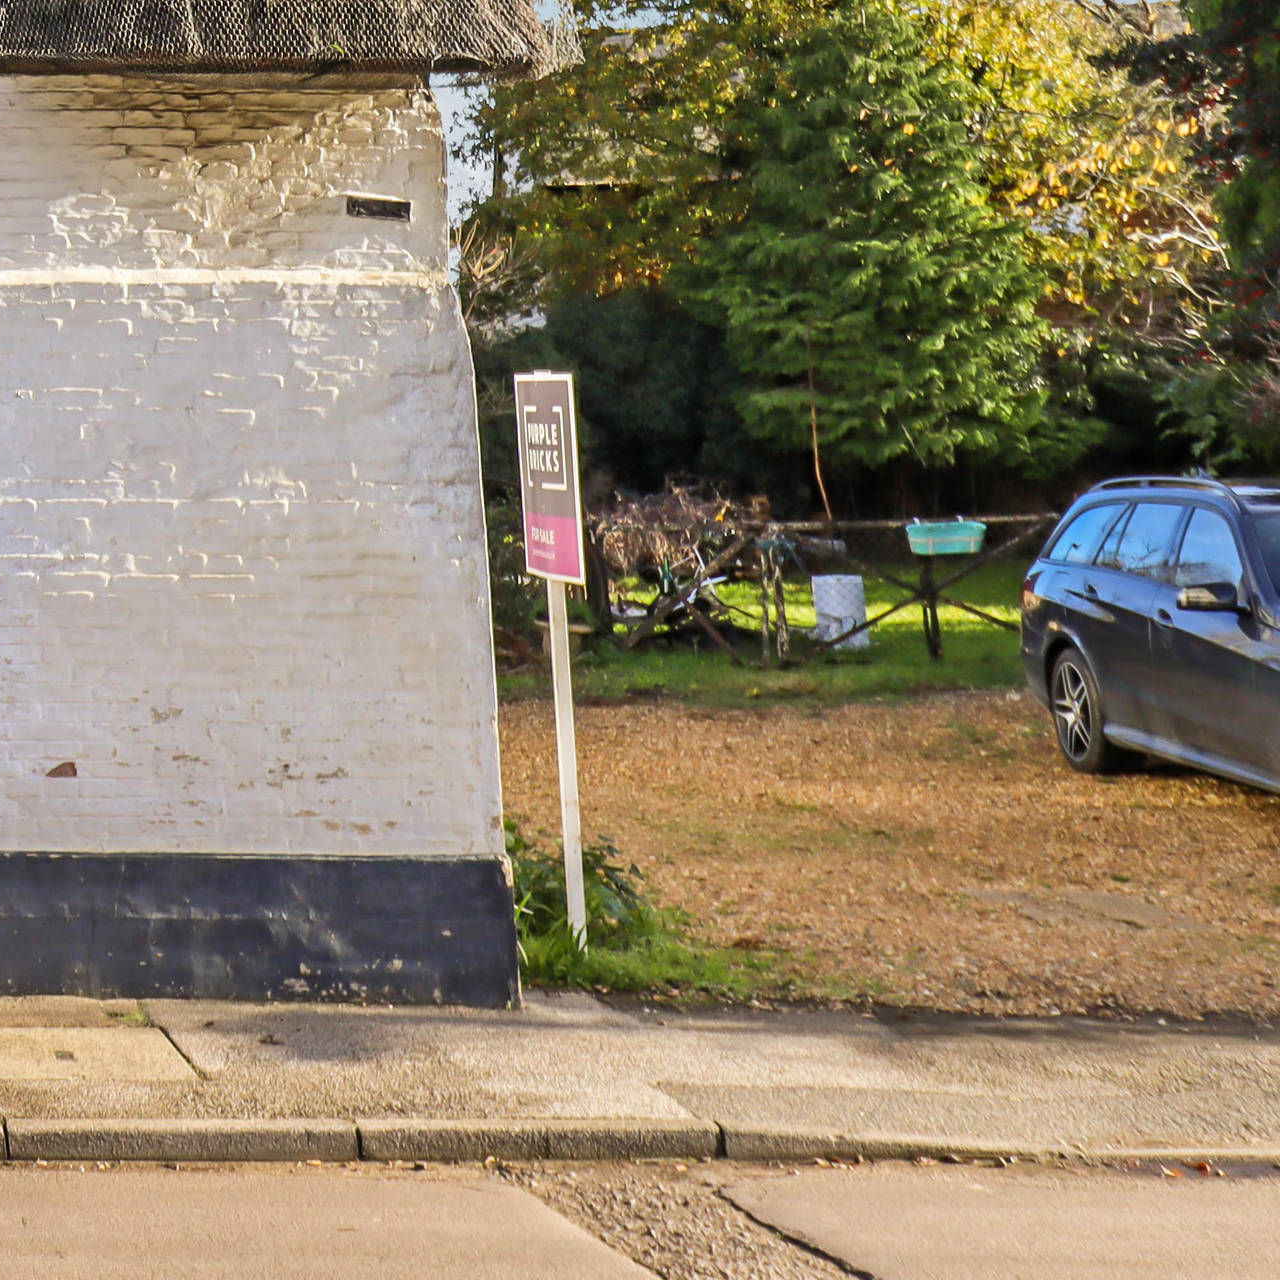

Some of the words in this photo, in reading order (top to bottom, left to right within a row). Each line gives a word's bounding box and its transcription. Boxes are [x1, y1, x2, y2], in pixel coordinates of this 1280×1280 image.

[527, 422, 558, 446] PURPLE
[529, 448, 560, 473] BRICKS
[540, 528, 555, 545] SALE
